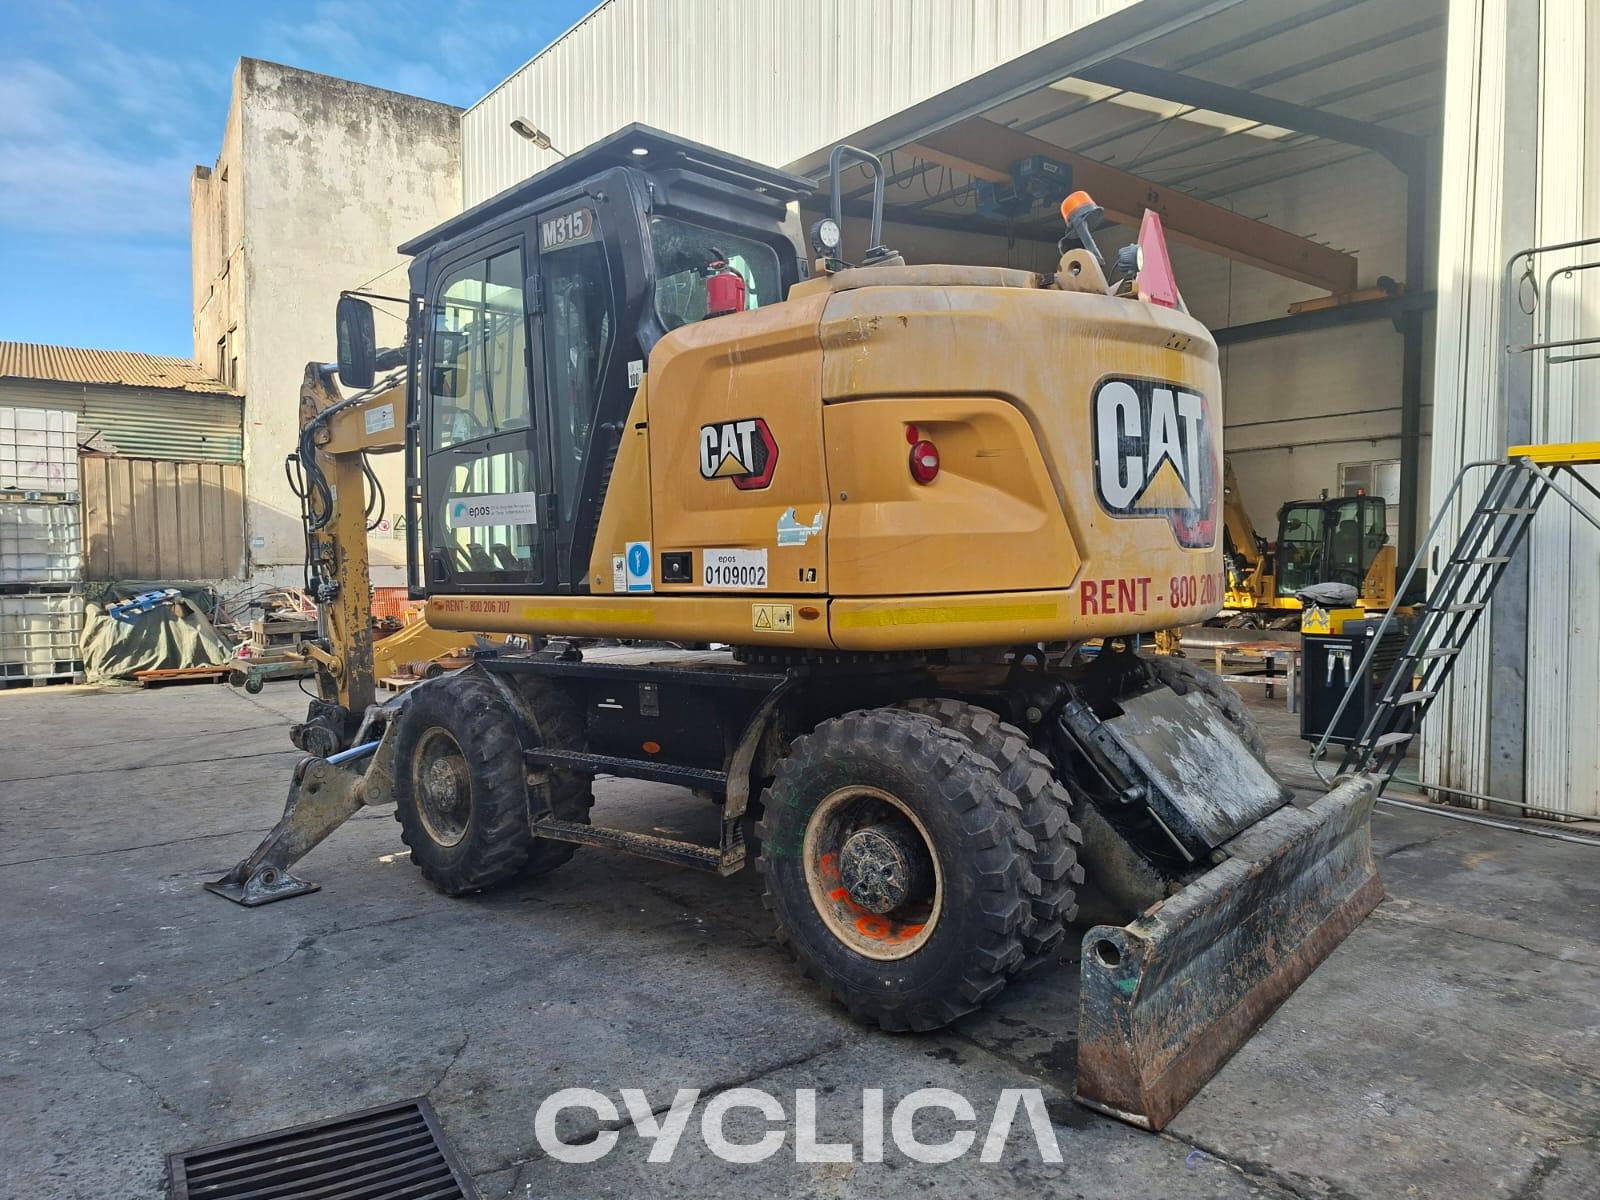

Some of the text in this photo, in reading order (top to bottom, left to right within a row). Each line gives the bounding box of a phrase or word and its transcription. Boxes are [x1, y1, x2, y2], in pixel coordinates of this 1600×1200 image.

[543, 211, 583, 248] M315
[700, 420, 756, 478] CAT
[1097, 381, 1202, 509] CAT
[469, 506, 490, 518] epos
[718, 555, 736, 563] epos
[705, 566, 766, 585] 0109002
[445, 600, 464, 612] RENT
[470, 601, 482, 612] 800
[484, 601, 496, 612] 206
[498, 601, 510, 613] 707
[1080, 577, 1151, 615] RENT
[1170, 576, 1196, 608] 800
